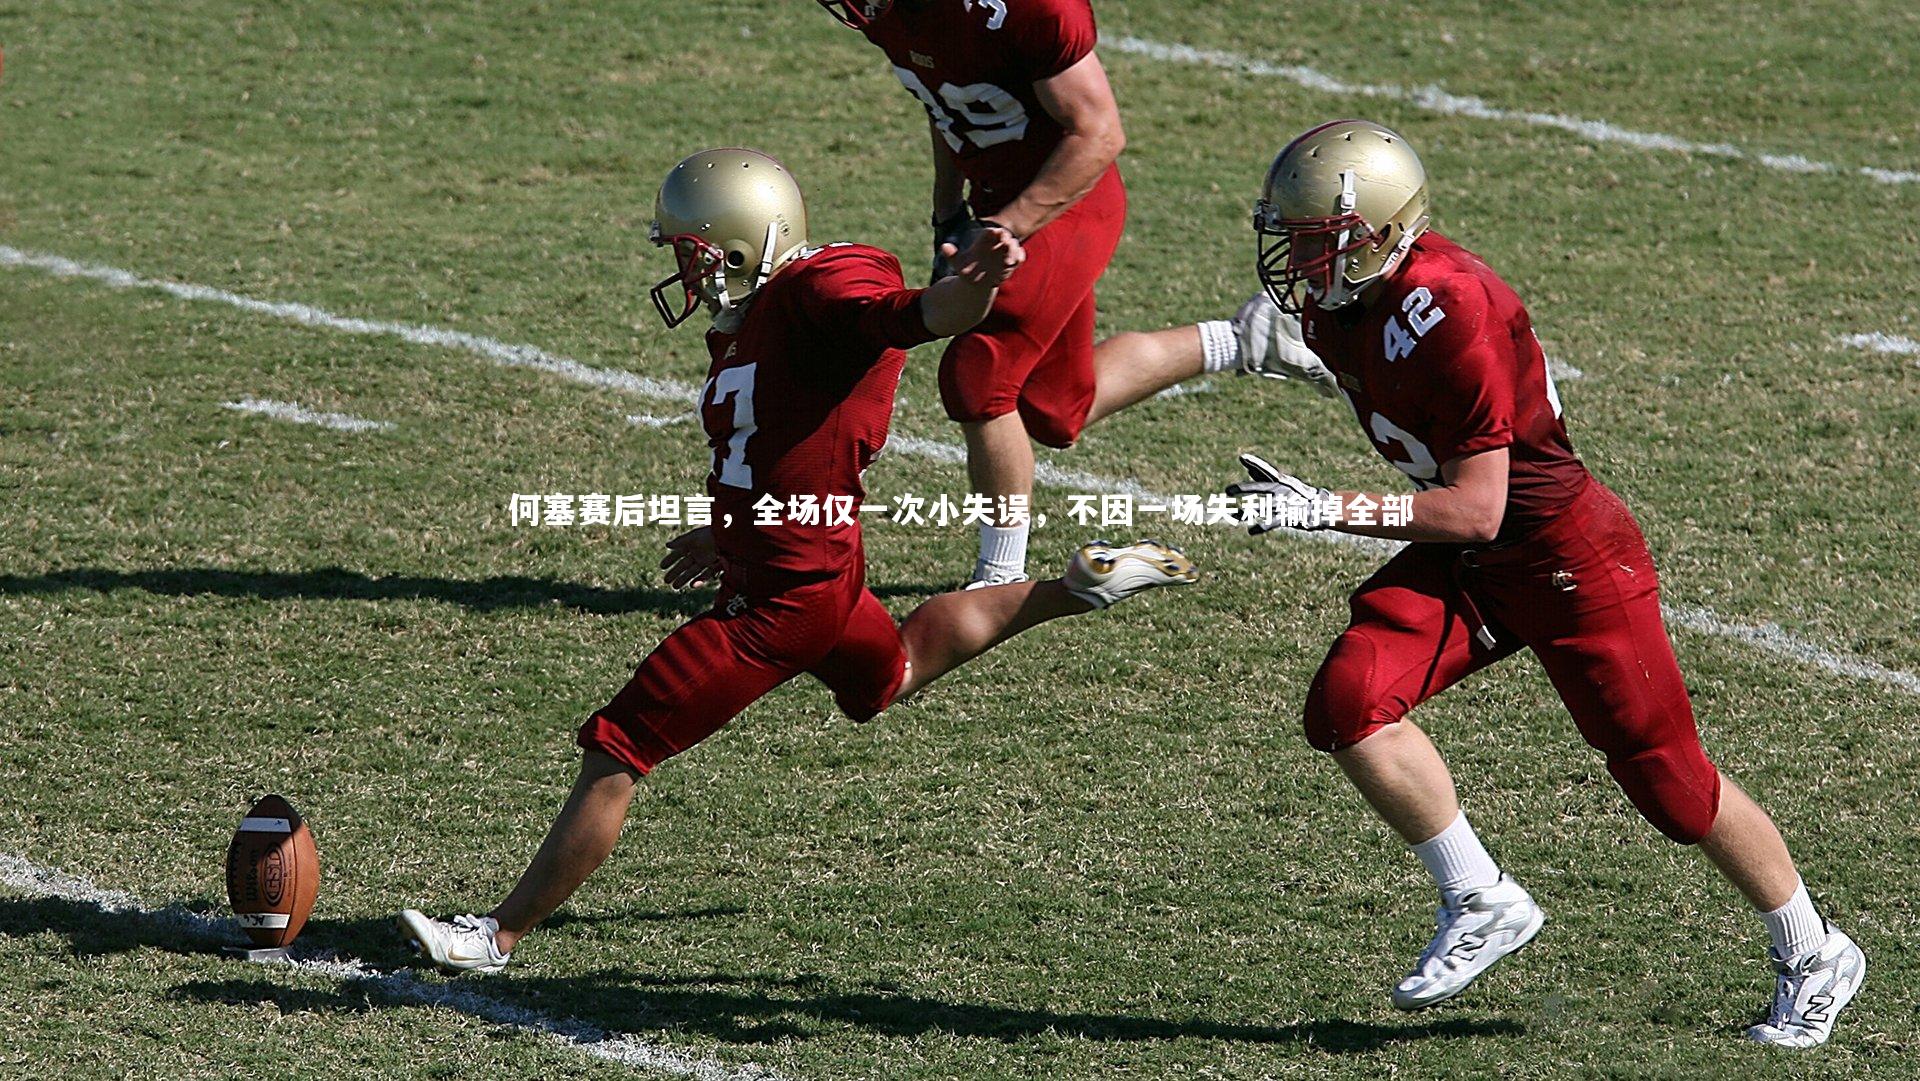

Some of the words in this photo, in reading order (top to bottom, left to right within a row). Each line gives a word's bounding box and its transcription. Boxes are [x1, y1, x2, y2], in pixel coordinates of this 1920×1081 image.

[1382, 286, 1446, 362] 42
[698, 362, 757, 489] 7
[1448, 932, 1487, 961] N
[1802, 995, 1834, 1022] N
